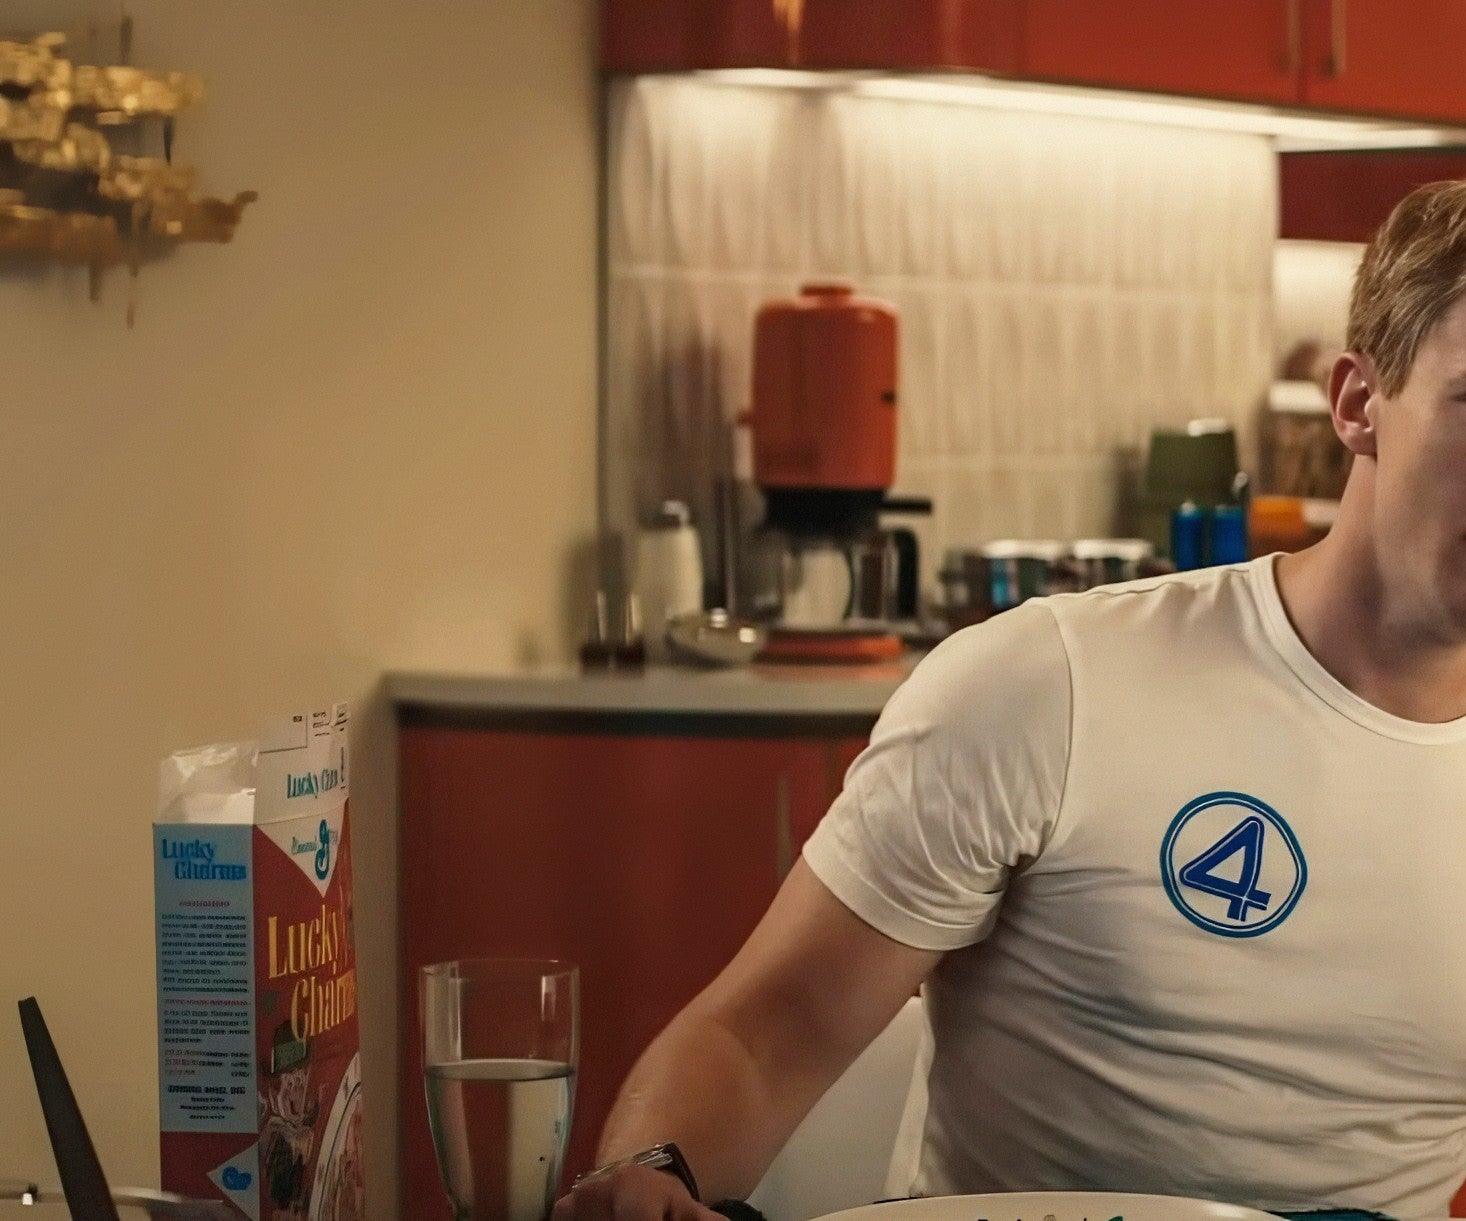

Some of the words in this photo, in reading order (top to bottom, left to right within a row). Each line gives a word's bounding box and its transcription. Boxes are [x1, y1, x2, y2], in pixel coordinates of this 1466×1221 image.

[287, 772, 319, 799] Lucky
[162, 838, 214, 863] Lucky
[1179, 816, 1272, 922] 4
[268, 904, 338, 979] Lucky
